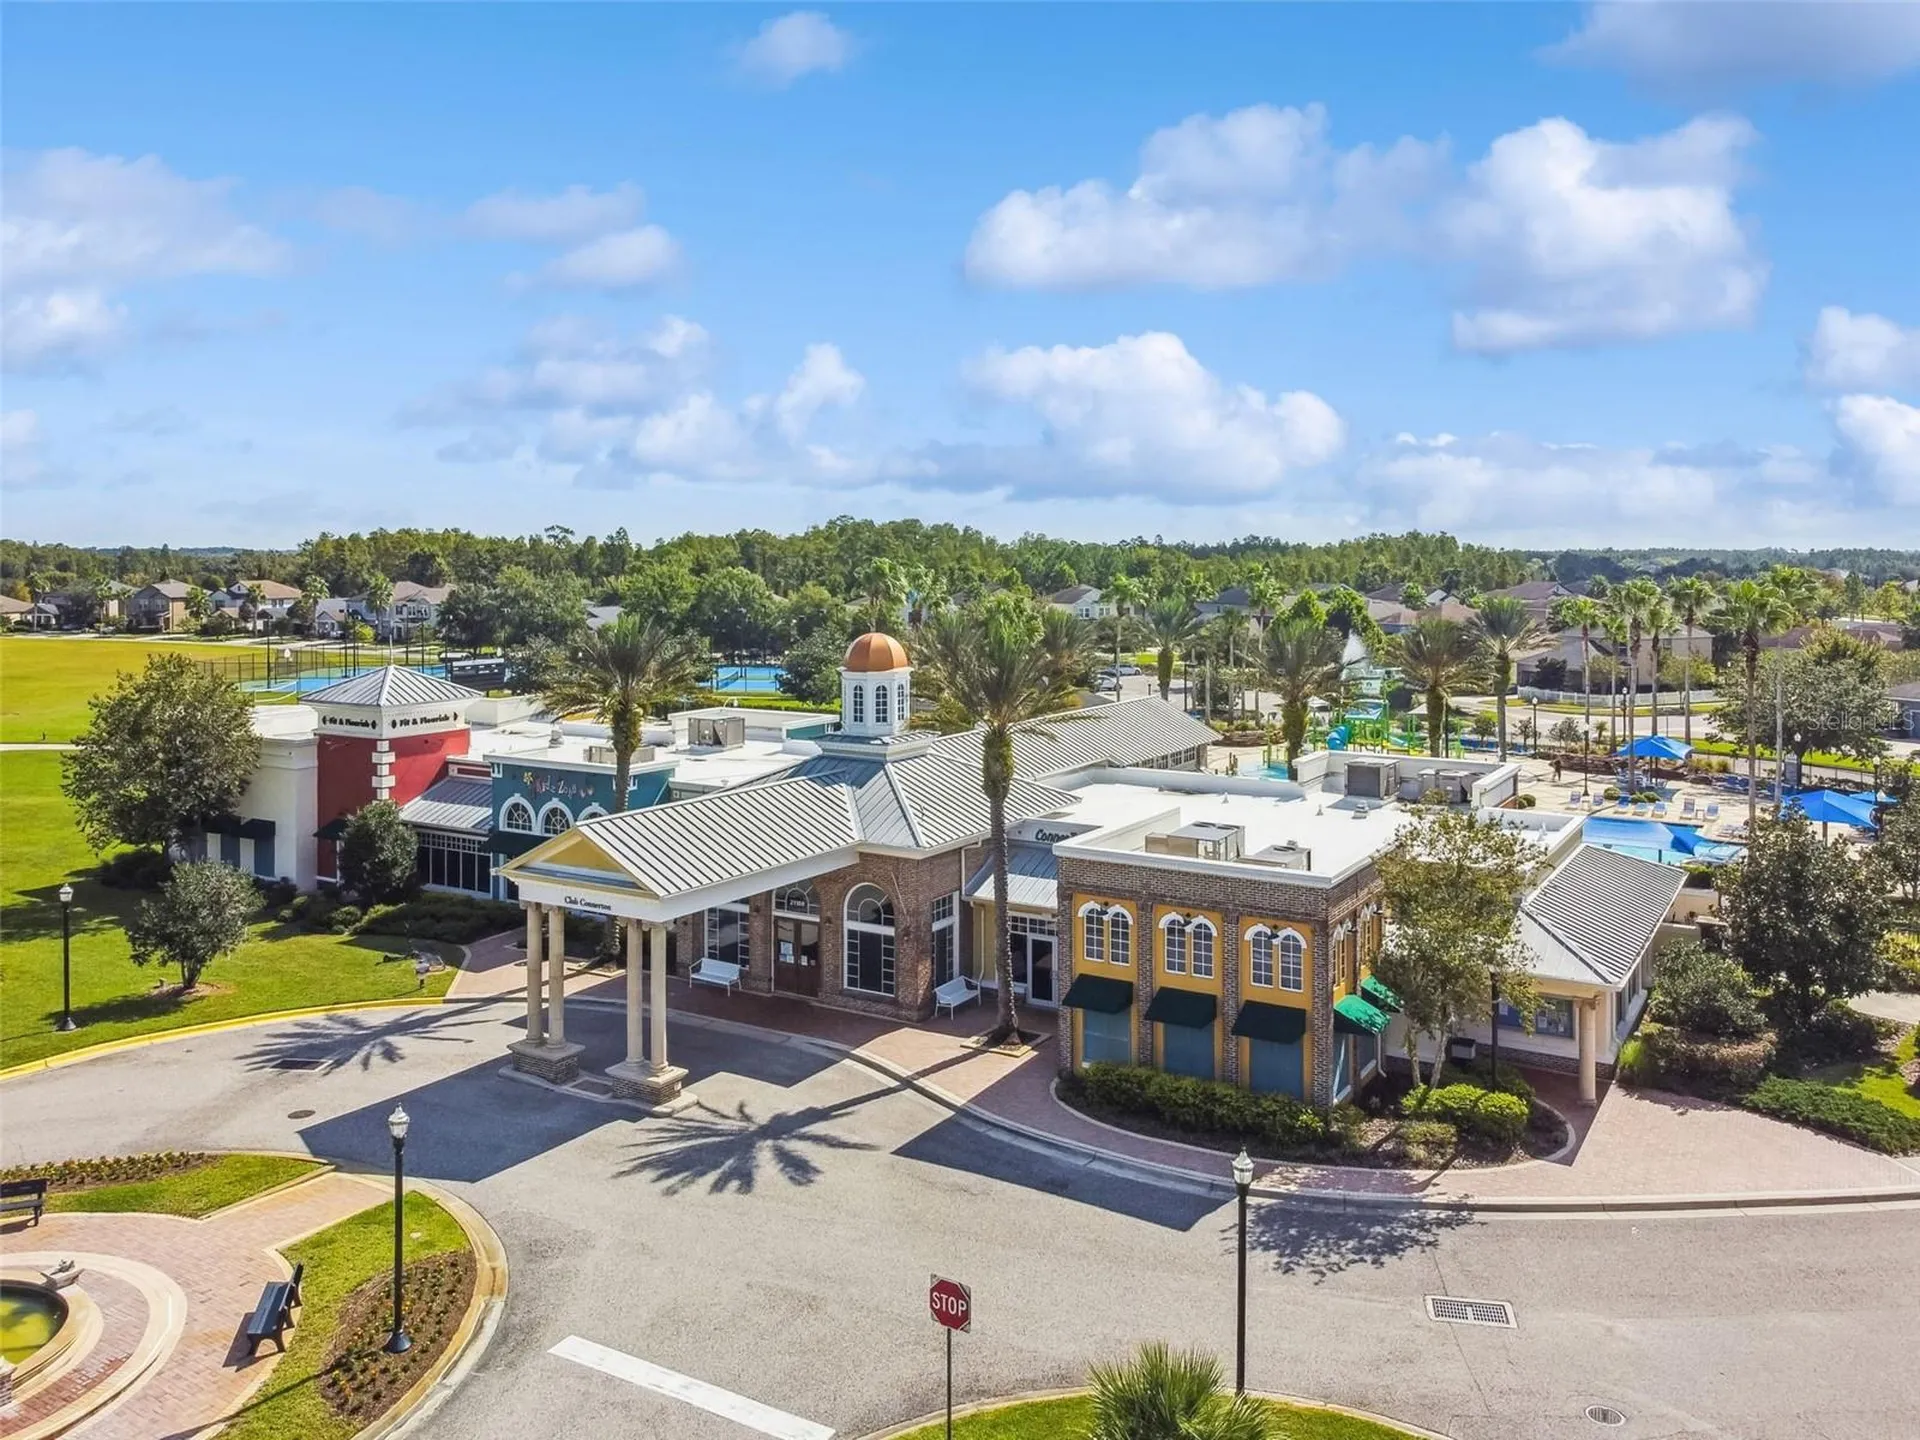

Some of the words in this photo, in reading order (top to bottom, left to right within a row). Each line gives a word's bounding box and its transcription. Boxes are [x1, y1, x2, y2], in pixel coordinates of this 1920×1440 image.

[420, 713, 450, 725] Flourish
[564, 896, 579, 905] Club
[580, 898, 611, 911] Connerton
[932, 1292, 967, 1317] STOP
